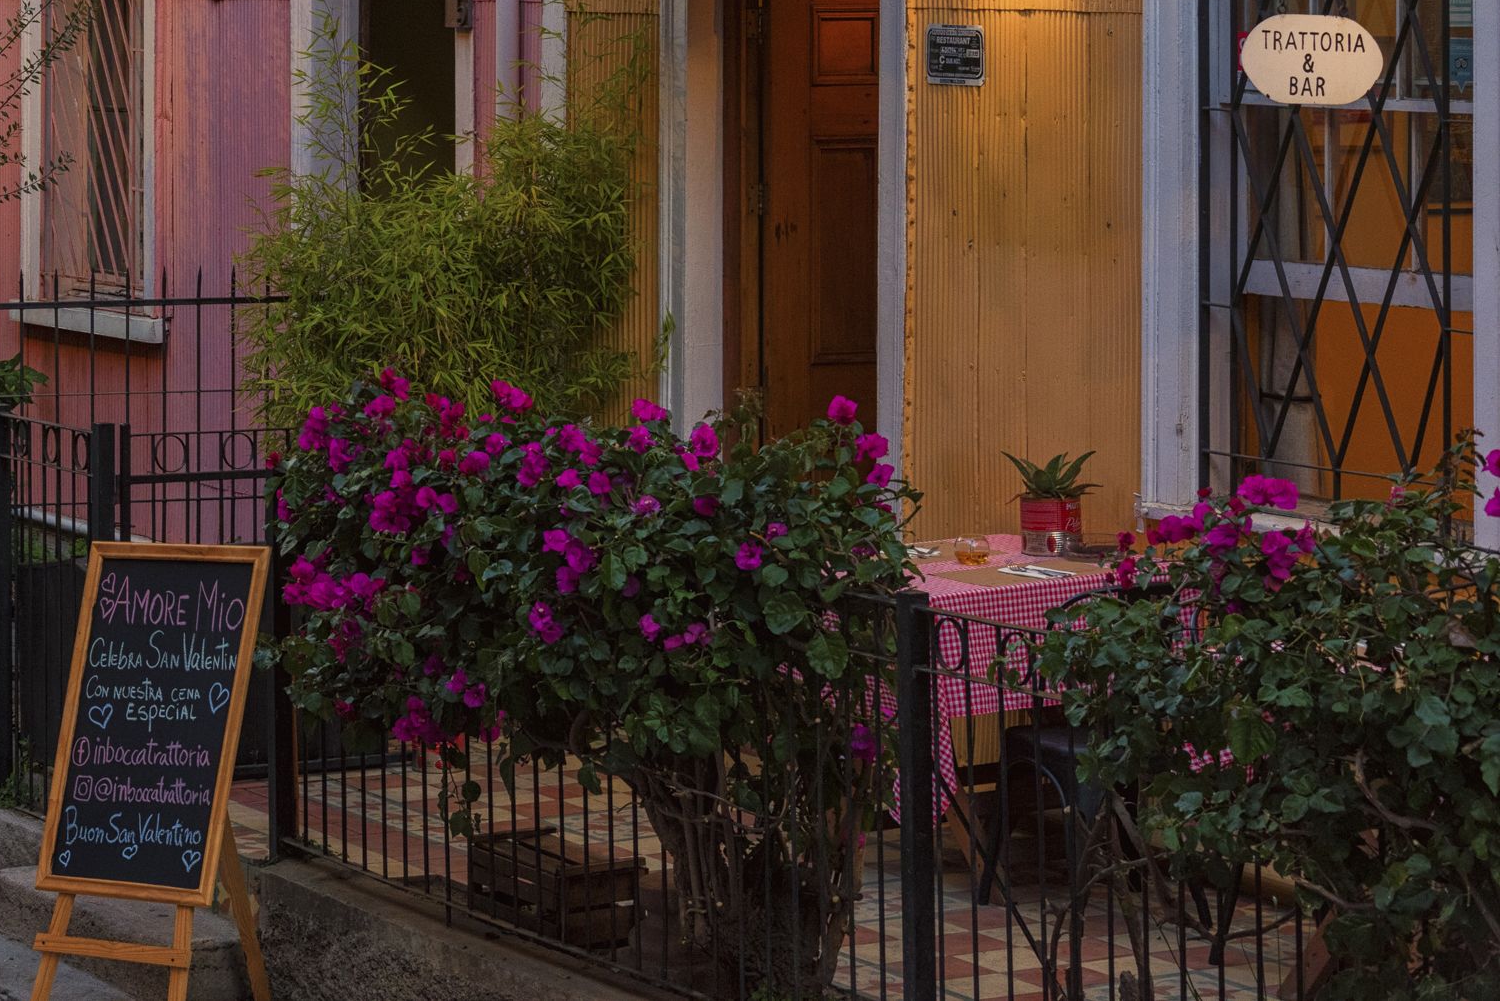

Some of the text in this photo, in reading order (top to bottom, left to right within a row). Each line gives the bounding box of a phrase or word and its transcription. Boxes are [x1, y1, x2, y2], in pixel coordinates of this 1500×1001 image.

[936, 36, 971, 45] RESTAURANT
[1261, 30, 1366, 53] TRATTORIA
[1303, 54, 1315, 73] &
[1289, 76, 1326, 97] BAR
[108, 575, 190, 626] AMORE
[113, 677, 164, 702] NUESTRA
[170, 687, 201, 702] CENA
[93, 736, 211, 767] inboccatrattoria
[65, 805, 202, 847] Buon San Valentino
